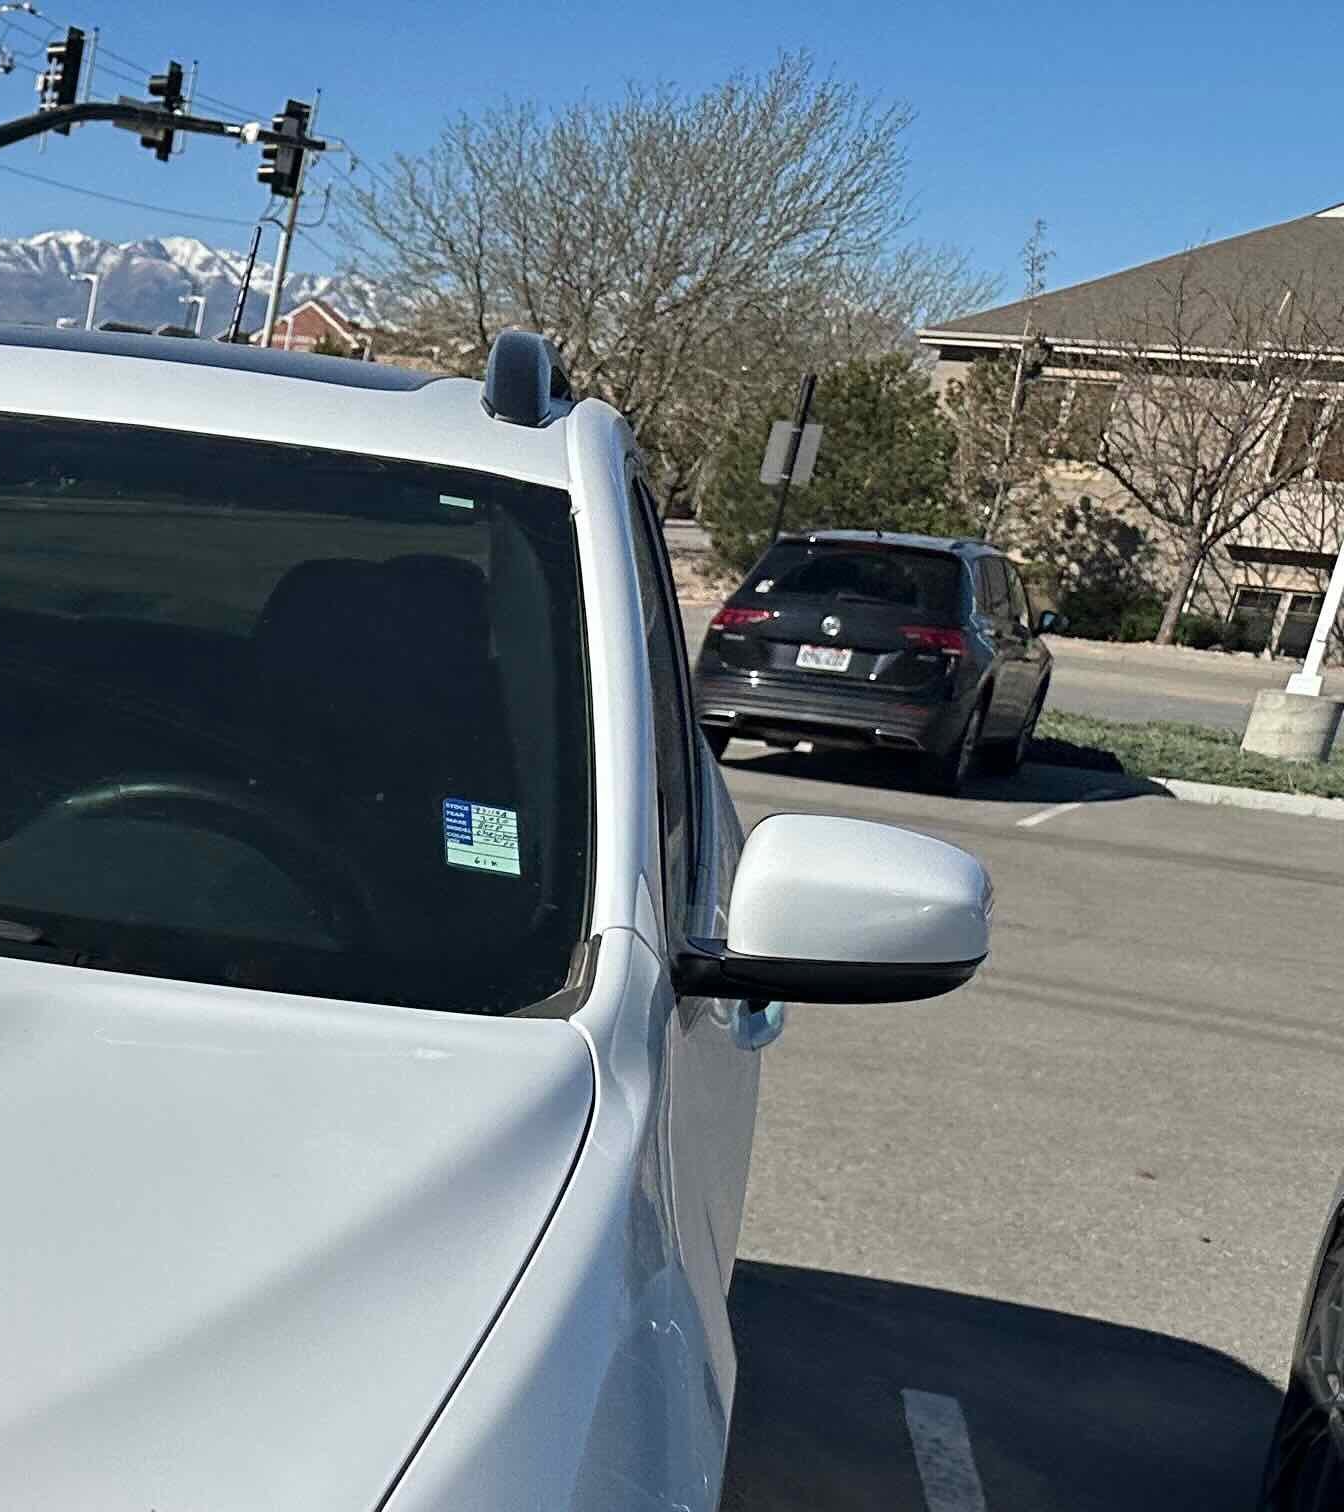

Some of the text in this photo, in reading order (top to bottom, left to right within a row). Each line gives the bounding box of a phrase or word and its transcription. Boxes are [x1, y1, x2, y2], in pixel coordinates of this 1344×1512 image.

[445, 802, 470, 812] STOCK
[446, 810, 465, 818] YEAR
[446, 831, 472, 841] COLOR
